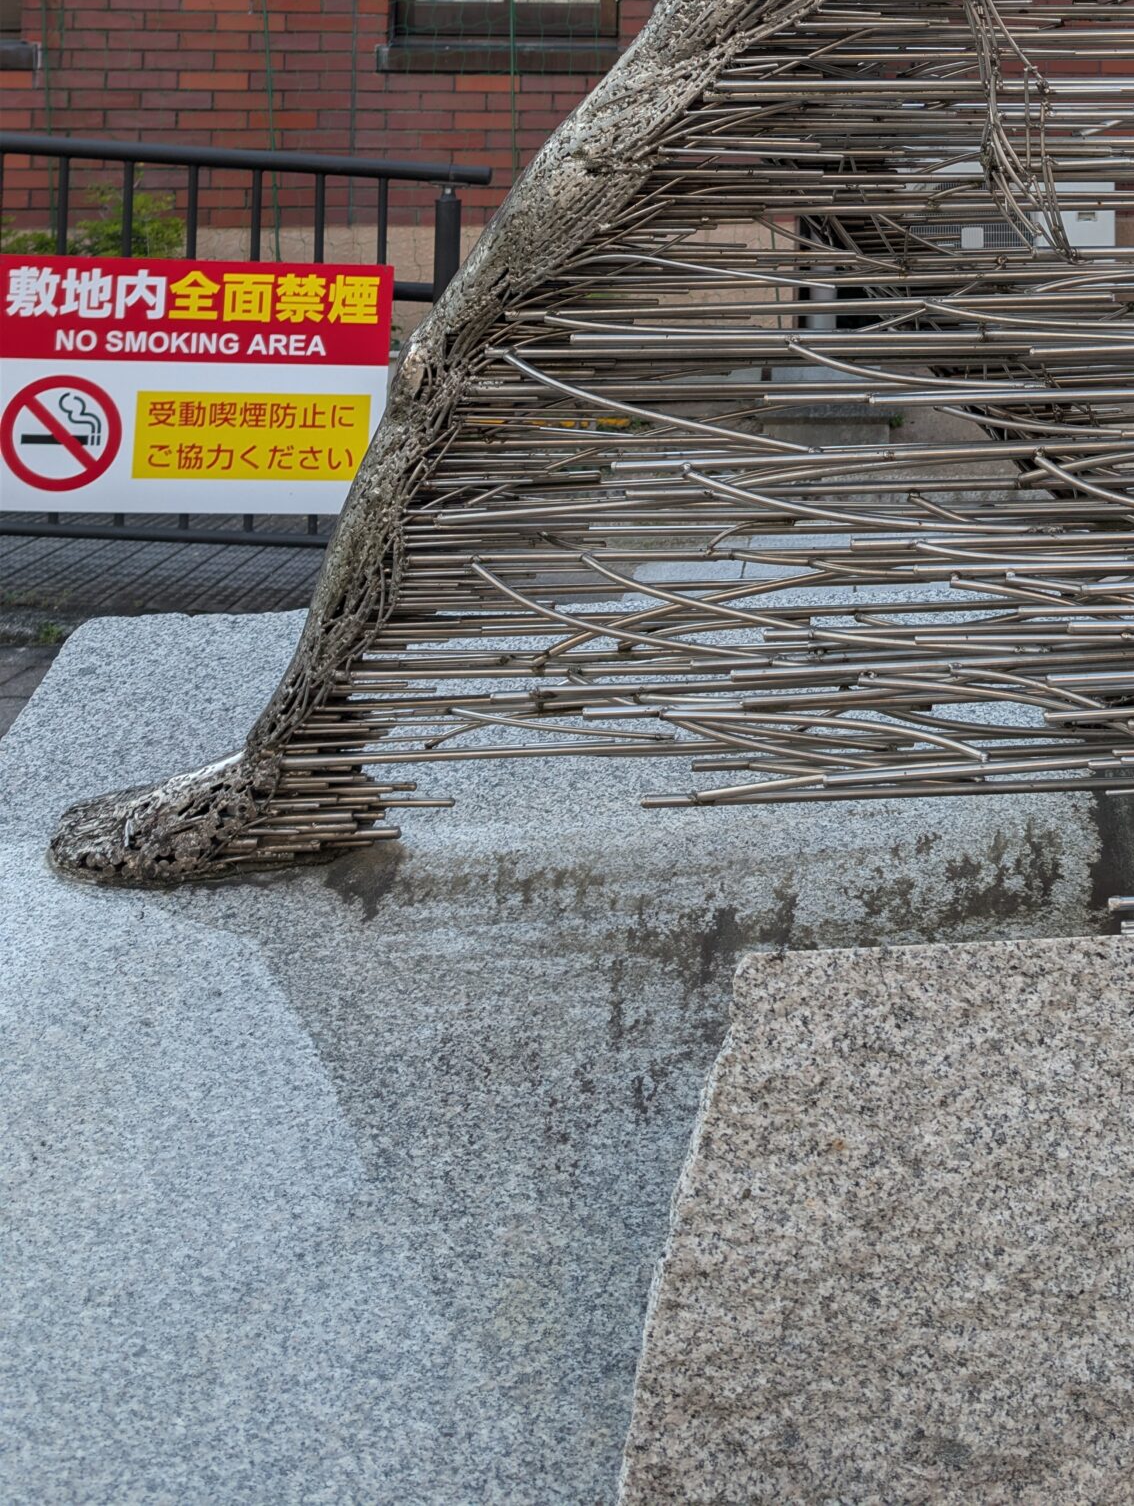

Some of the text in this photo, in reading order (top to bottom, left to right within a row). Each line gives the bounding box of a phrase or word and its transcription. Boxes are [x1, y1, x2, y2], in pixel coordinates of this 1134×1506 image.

[6, 265, 381, 324] 敷地内全面禁煙
[55, 329, 326, 356] NO SMOKING AREA
[148, 400, 355, 429] 受動喫煙防止に
[147, 444, 354, 471] ご協力ください
